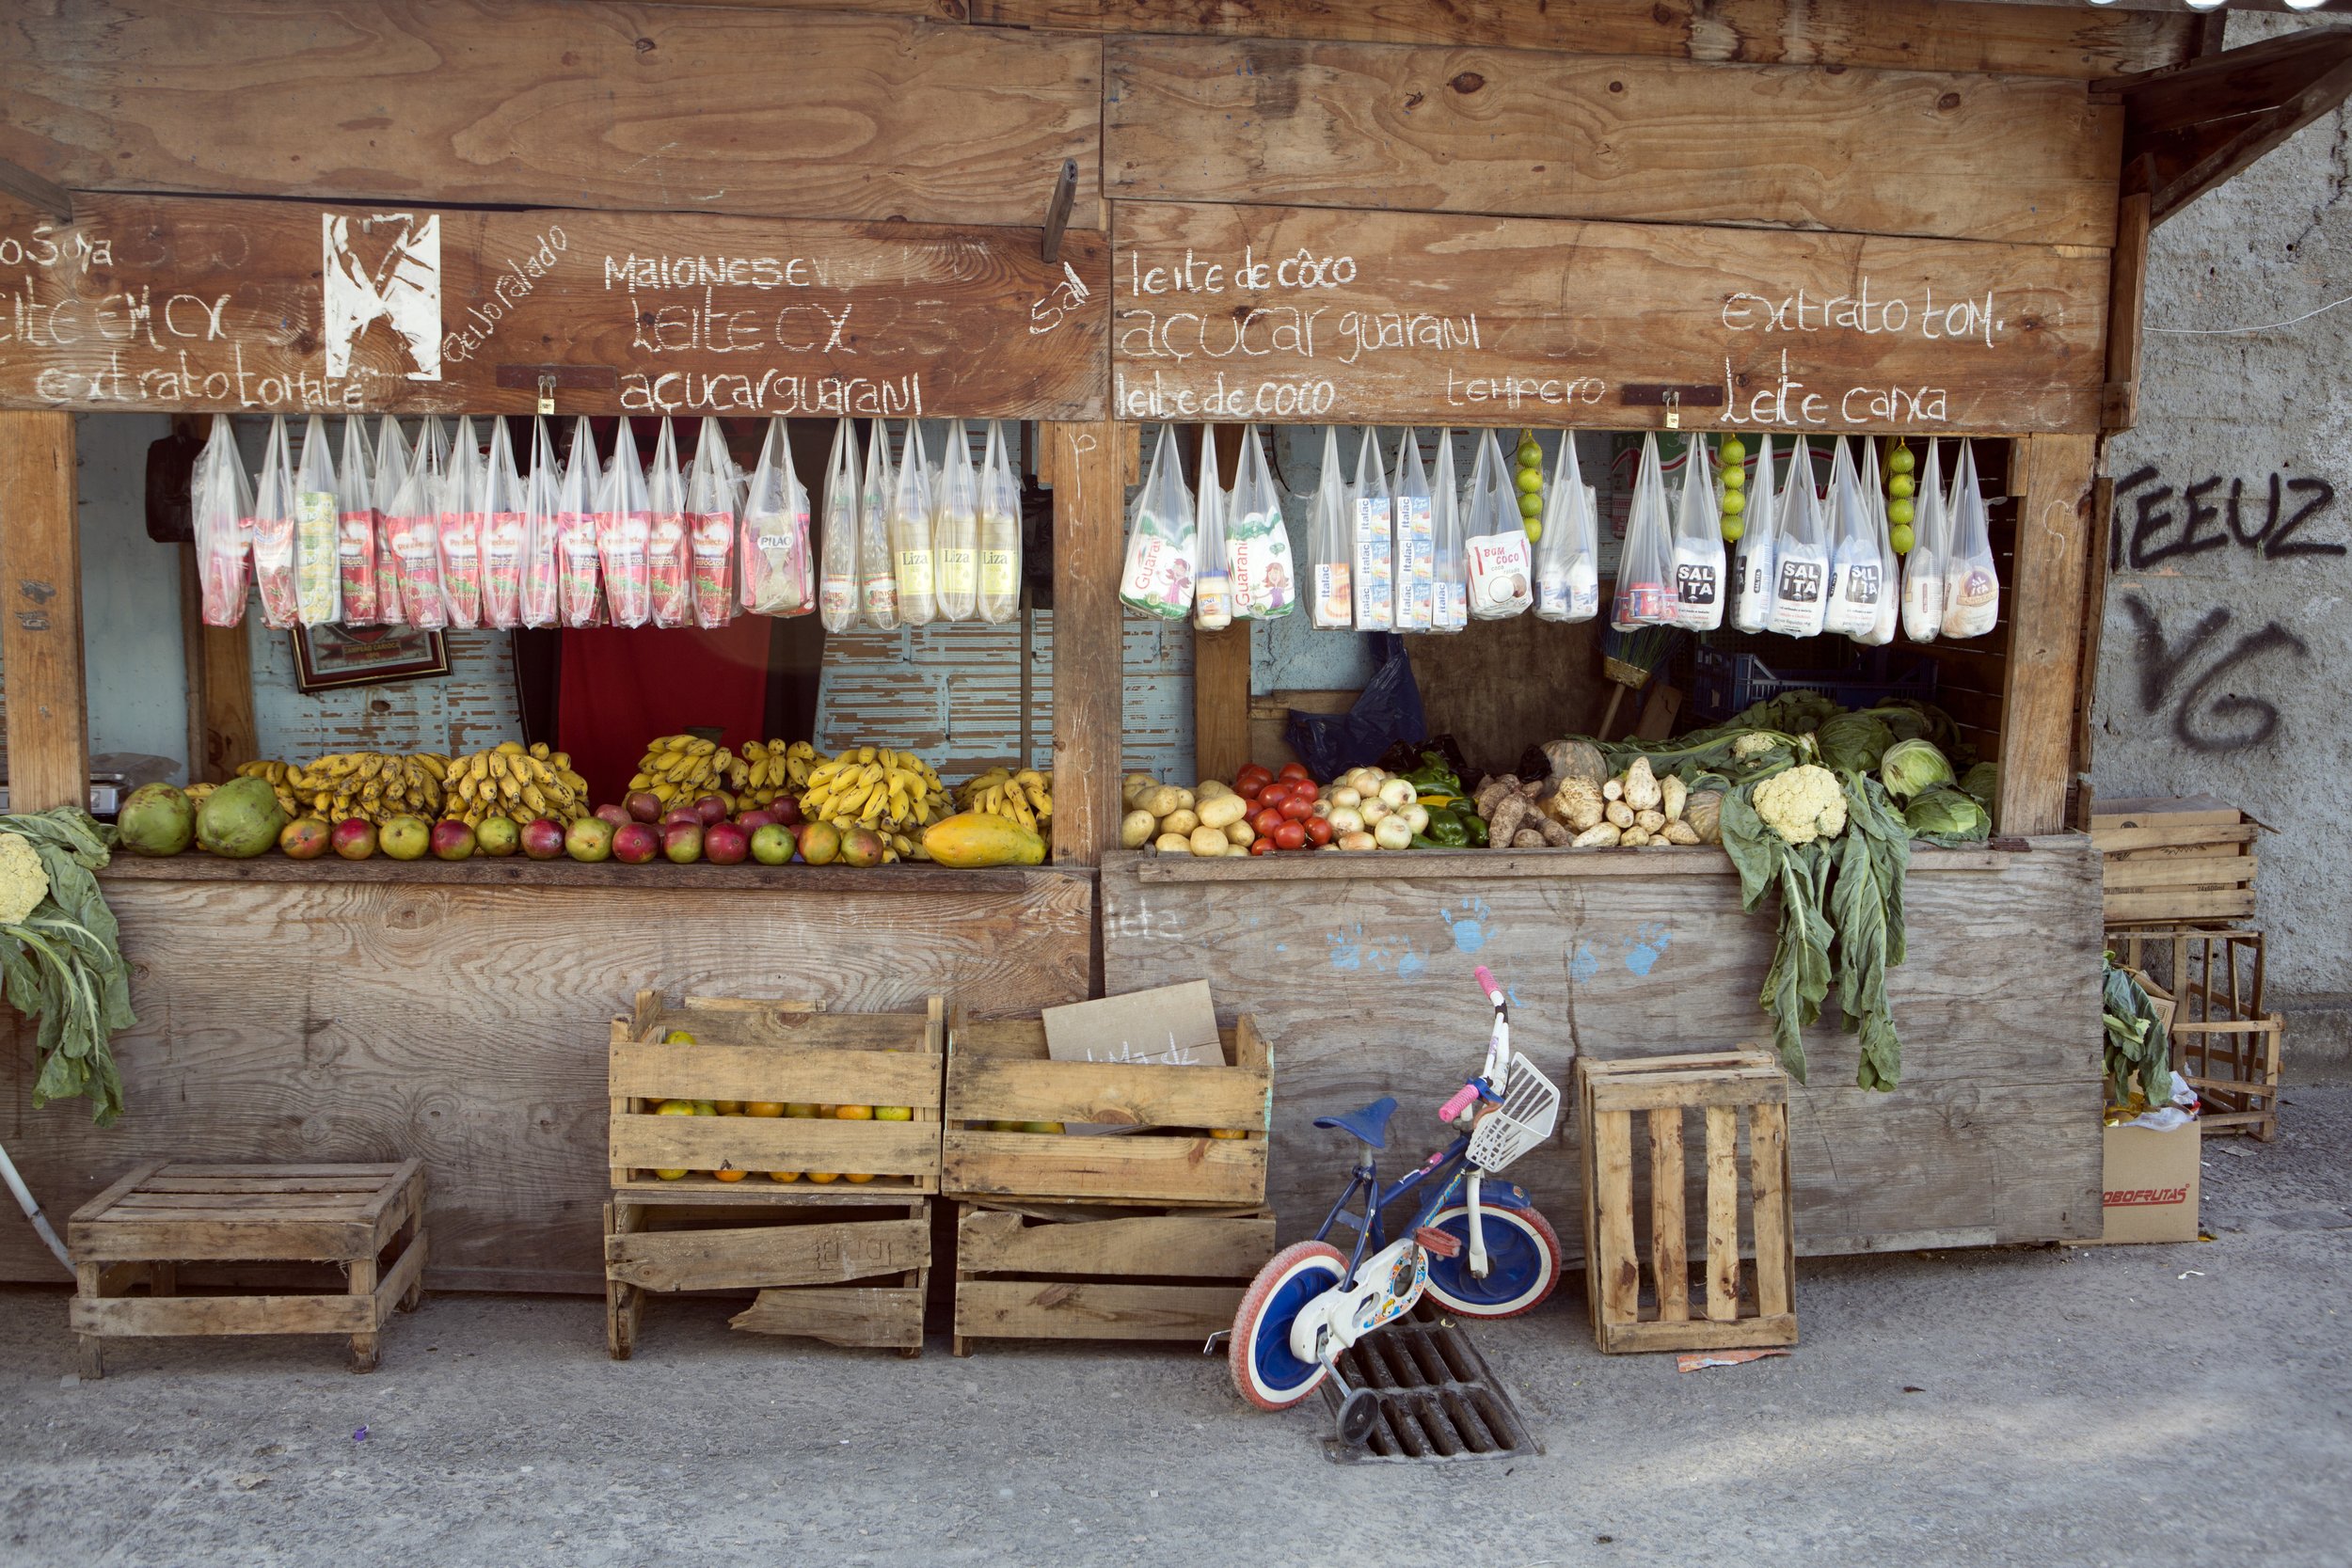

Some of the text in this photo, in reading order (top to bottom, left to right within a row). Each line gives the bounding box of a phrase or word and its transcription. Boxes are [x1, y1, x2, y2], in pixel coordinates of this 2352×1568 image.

[1496, 553, 1520, 565] COCO
[1677, 566, 1712, 581] SAL
[1784, 563, 1818, 579] SAL
